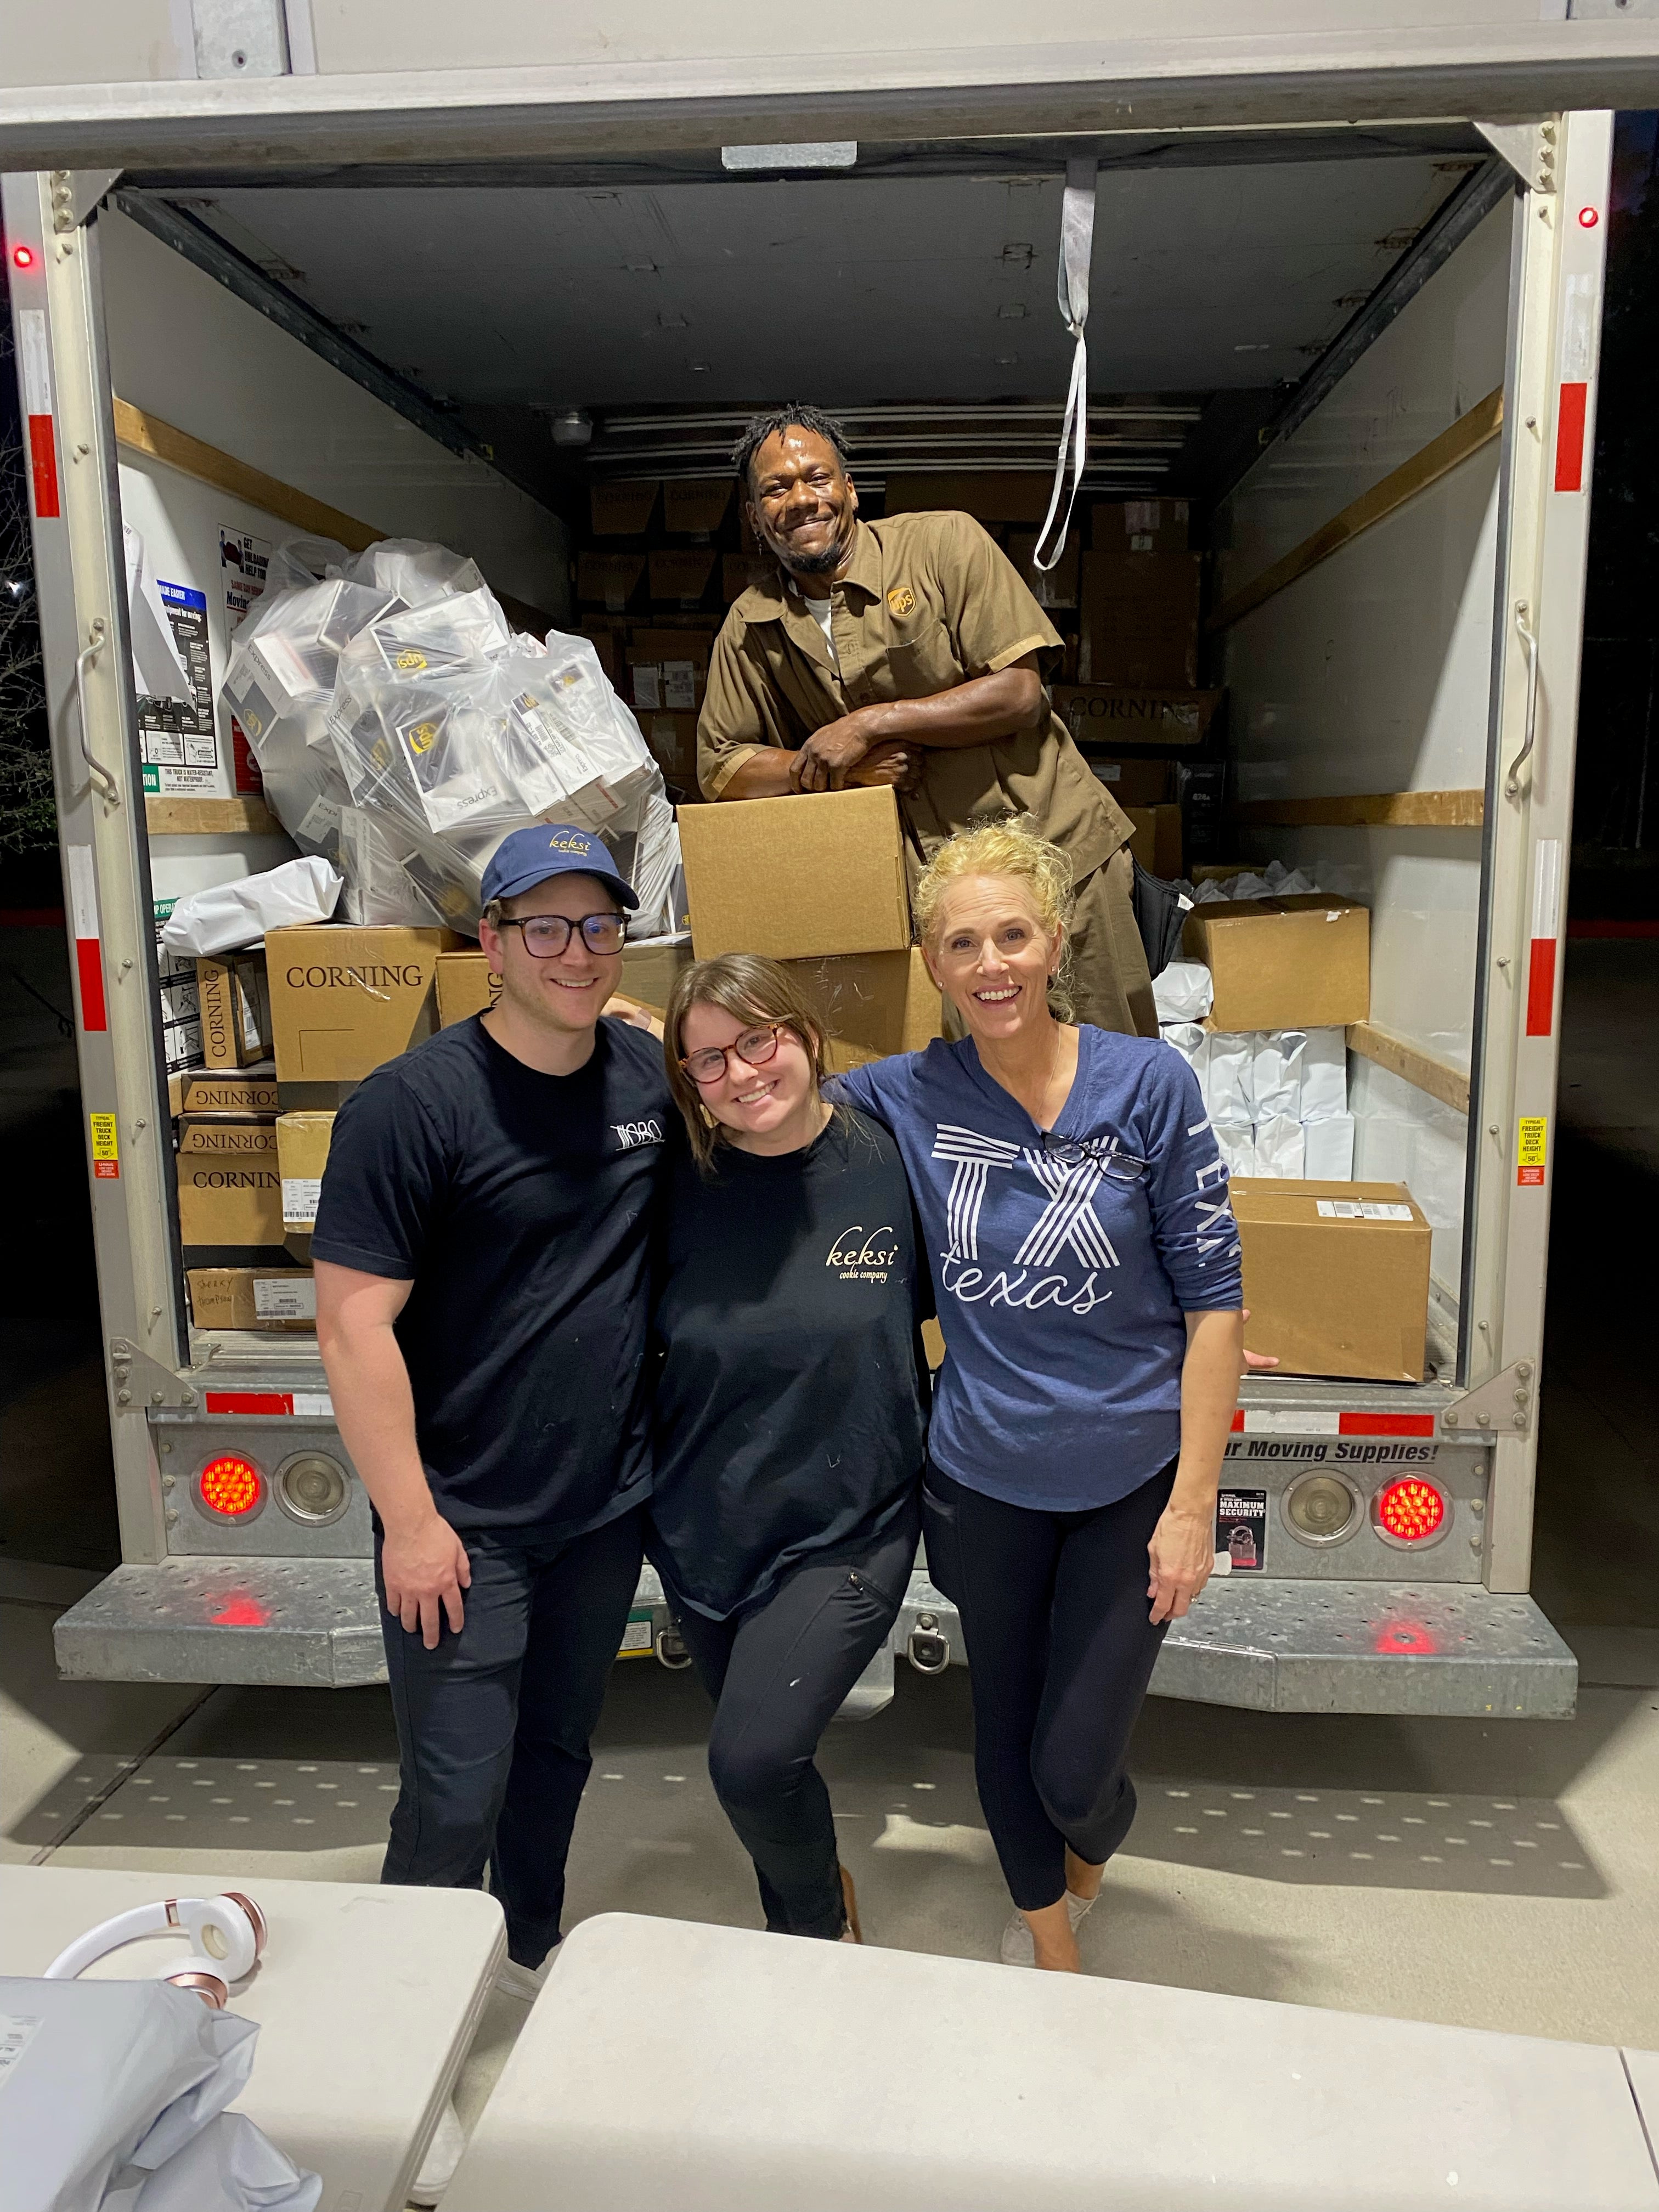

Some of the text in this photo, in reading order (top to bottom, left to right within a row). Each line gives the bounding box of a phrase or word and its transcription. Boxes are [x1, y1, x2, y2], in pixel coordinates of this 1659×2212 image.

[244, 537, 253, 550] GET
[891, 594, 913, 612] ups
[247, 644, 272, 681] Express
[329, 694, 352, 725] Express
[143, 774, 156, 786] TION
[457, 785, 498, 809] Express
[549, 831, 591, 850] keksi
[160, 903, 175, 915] OPERA
[286, 965, 424, 988] CORNING
[205, 969, 227, 1058] CORNING
[193, 1172, 281, 1188] CORNIN
[931, 1123, 1121, 1268] TX
[826, 1226, 899, 1266] keksi
[839, 1262, 888, 1284] cookie company
[940, 1240, 1113, 1314] texas
[1224, 1441, 1439, 1463] ur Moving Supplies!
[1219, 1509, 1265, 1517] SECURITY
[1220, 1501, 1265, 1509] MAXIMUM
